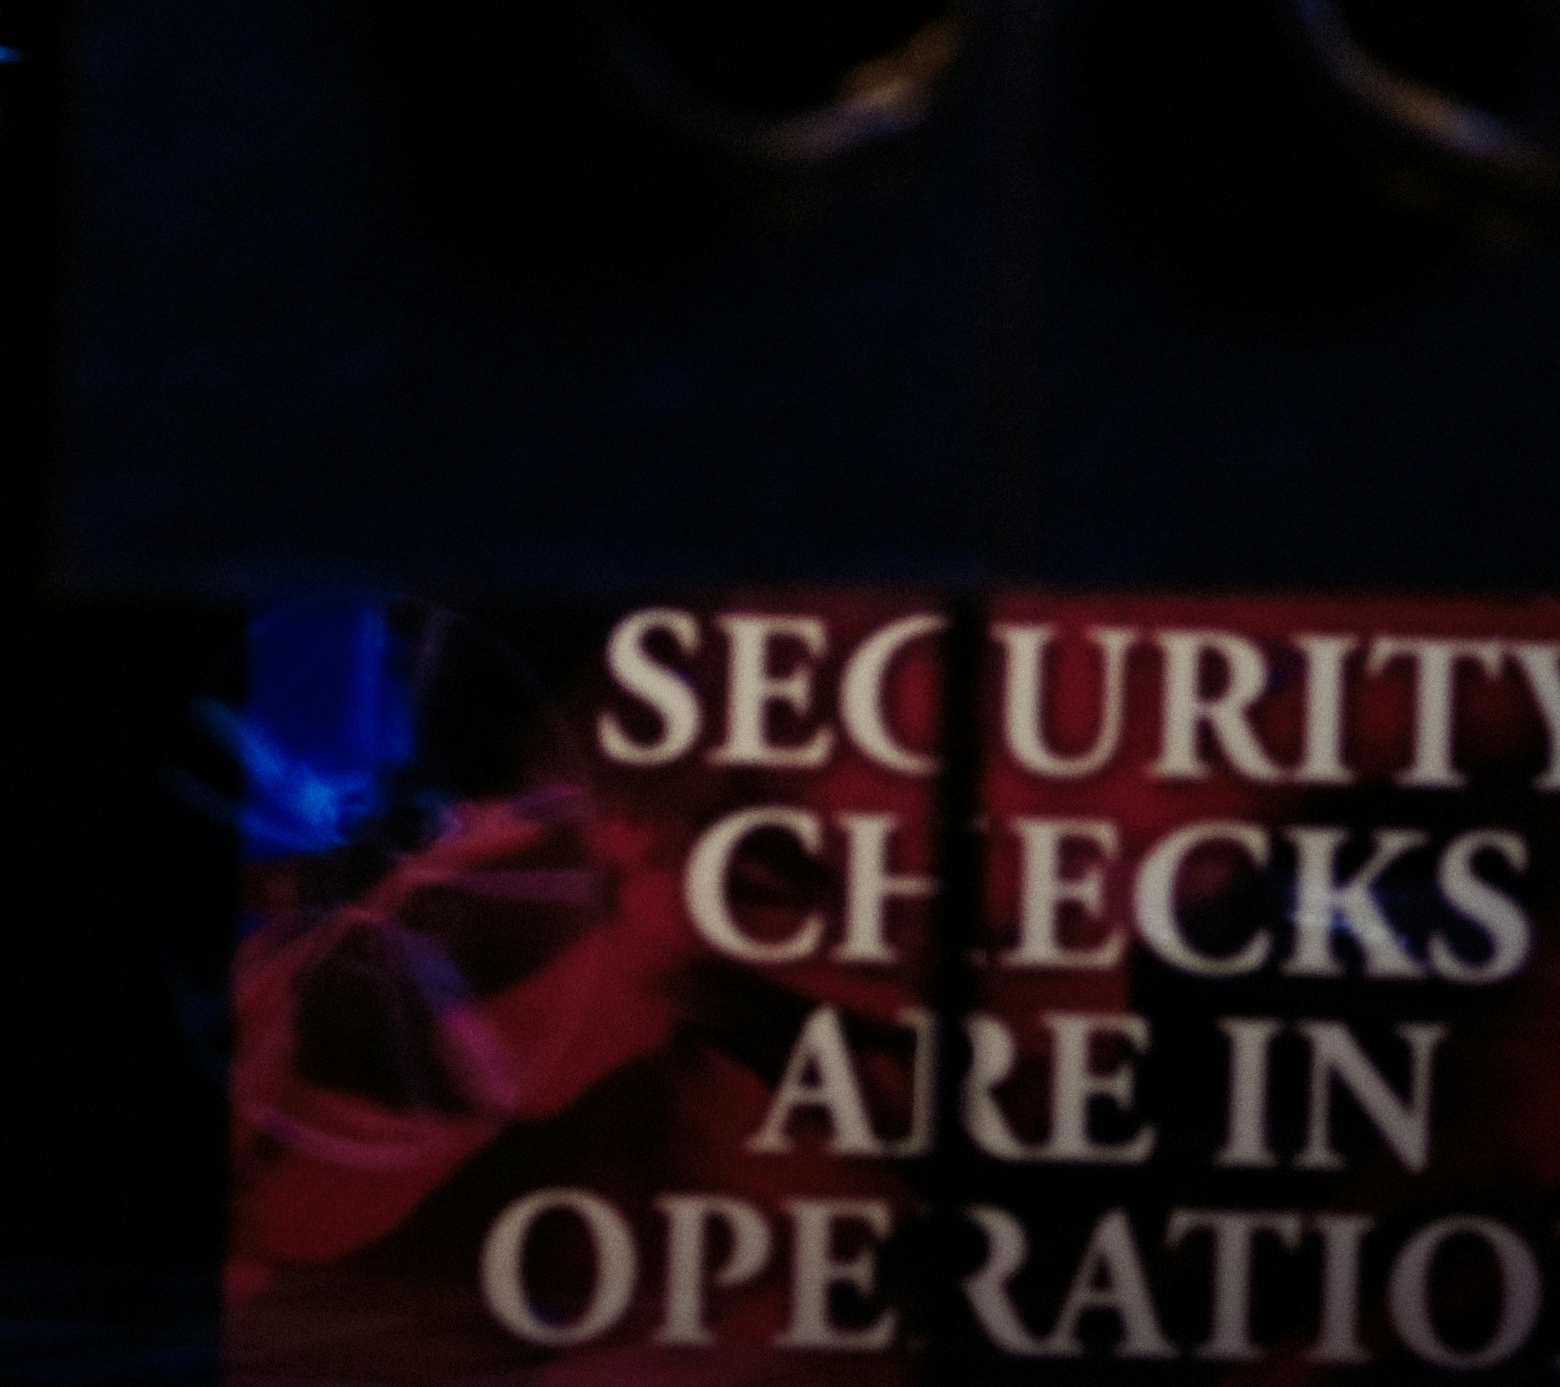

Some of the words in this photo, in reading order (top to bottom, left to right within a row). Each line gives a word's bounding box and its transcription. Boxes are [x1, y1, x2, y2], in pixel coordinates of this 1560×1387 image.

[681, 805, 1536, 991] CHECKS
[748, 1003, 1160, 1169] ARE
[1215, 1020, 1450, 1177] IN
